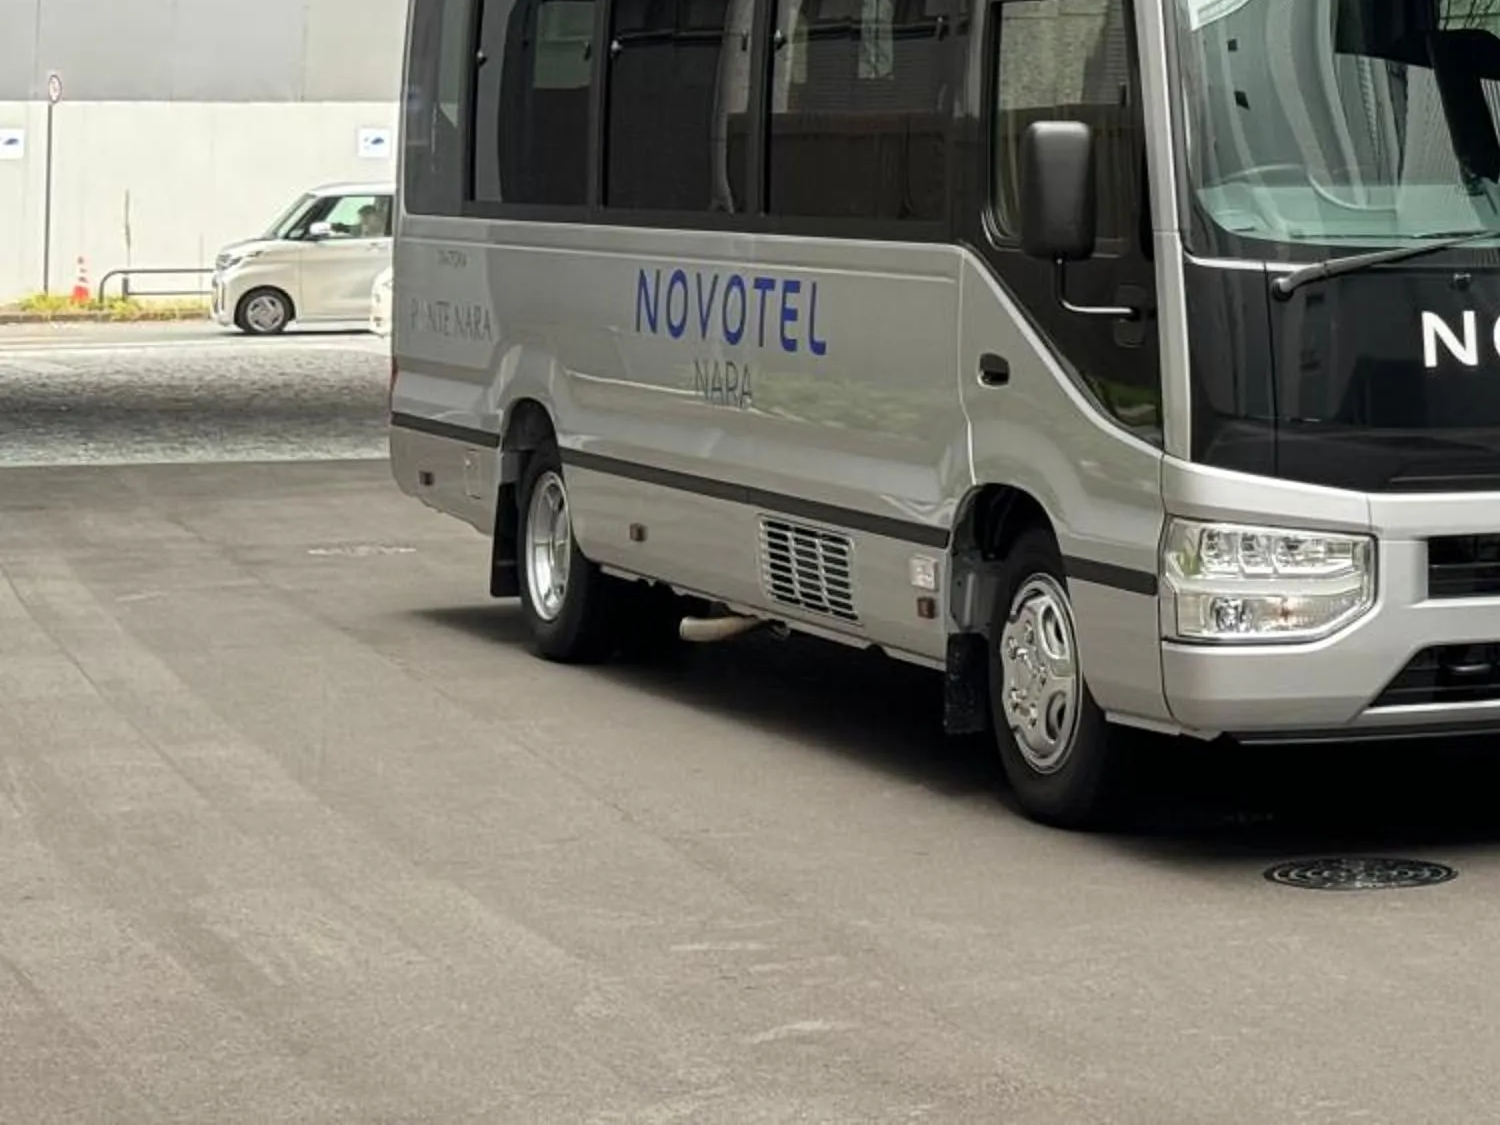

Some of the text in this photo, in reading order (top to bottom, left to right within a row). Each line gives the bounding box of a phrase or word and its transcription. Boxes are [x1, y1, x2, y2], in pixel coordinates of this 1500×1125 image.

[453, 303, 494, 342] NARA
[635, 268, 827, 356] NOVOTEL
[694, 359, 753, 410] NARA
